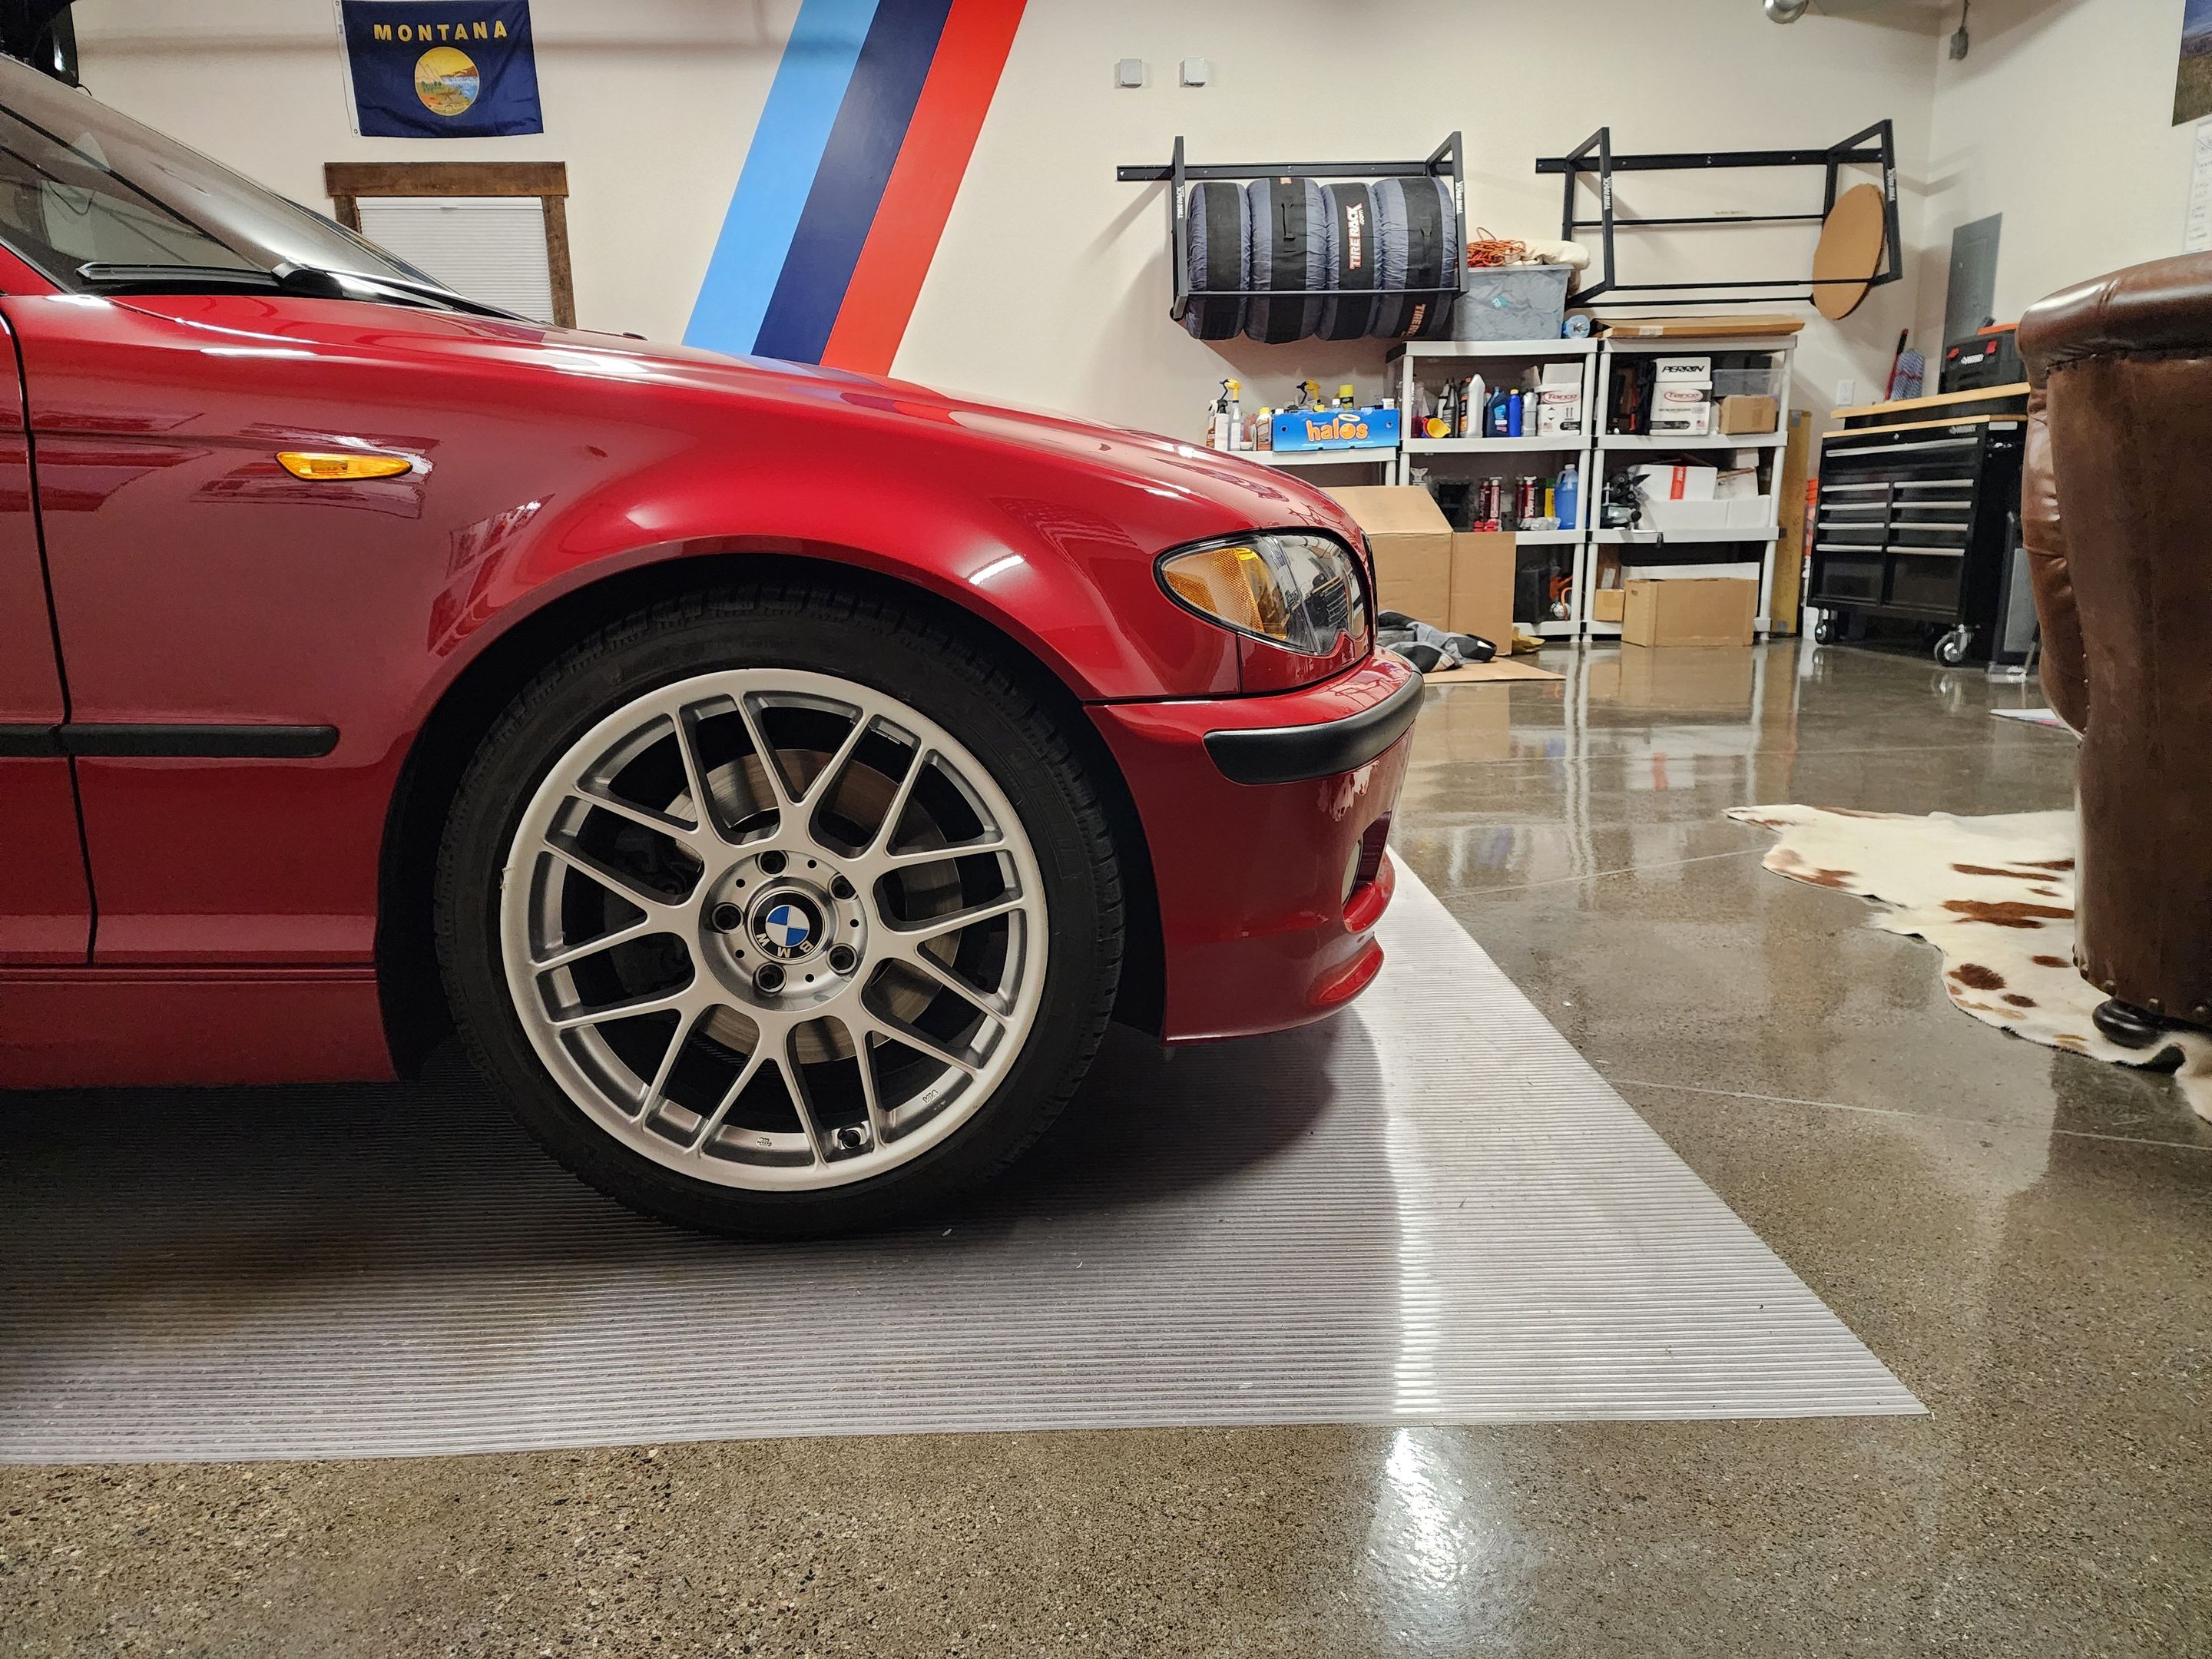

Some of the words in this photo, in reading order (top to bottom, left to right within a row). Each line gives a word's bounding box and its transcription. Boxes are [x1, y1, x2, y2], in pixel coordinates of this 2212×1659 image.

[373, 20, 508, 41] MONTANA
[1176, 185, 1185, 204] RACK
[1346, 202, 1363, 237] RACK
[1349, 237, 1361, 270] TIRE
[1411, 303, 1426, 325] TIRE
[1306, 417, 1368, 442] halos
[756, 932, 814, 959] BMW
